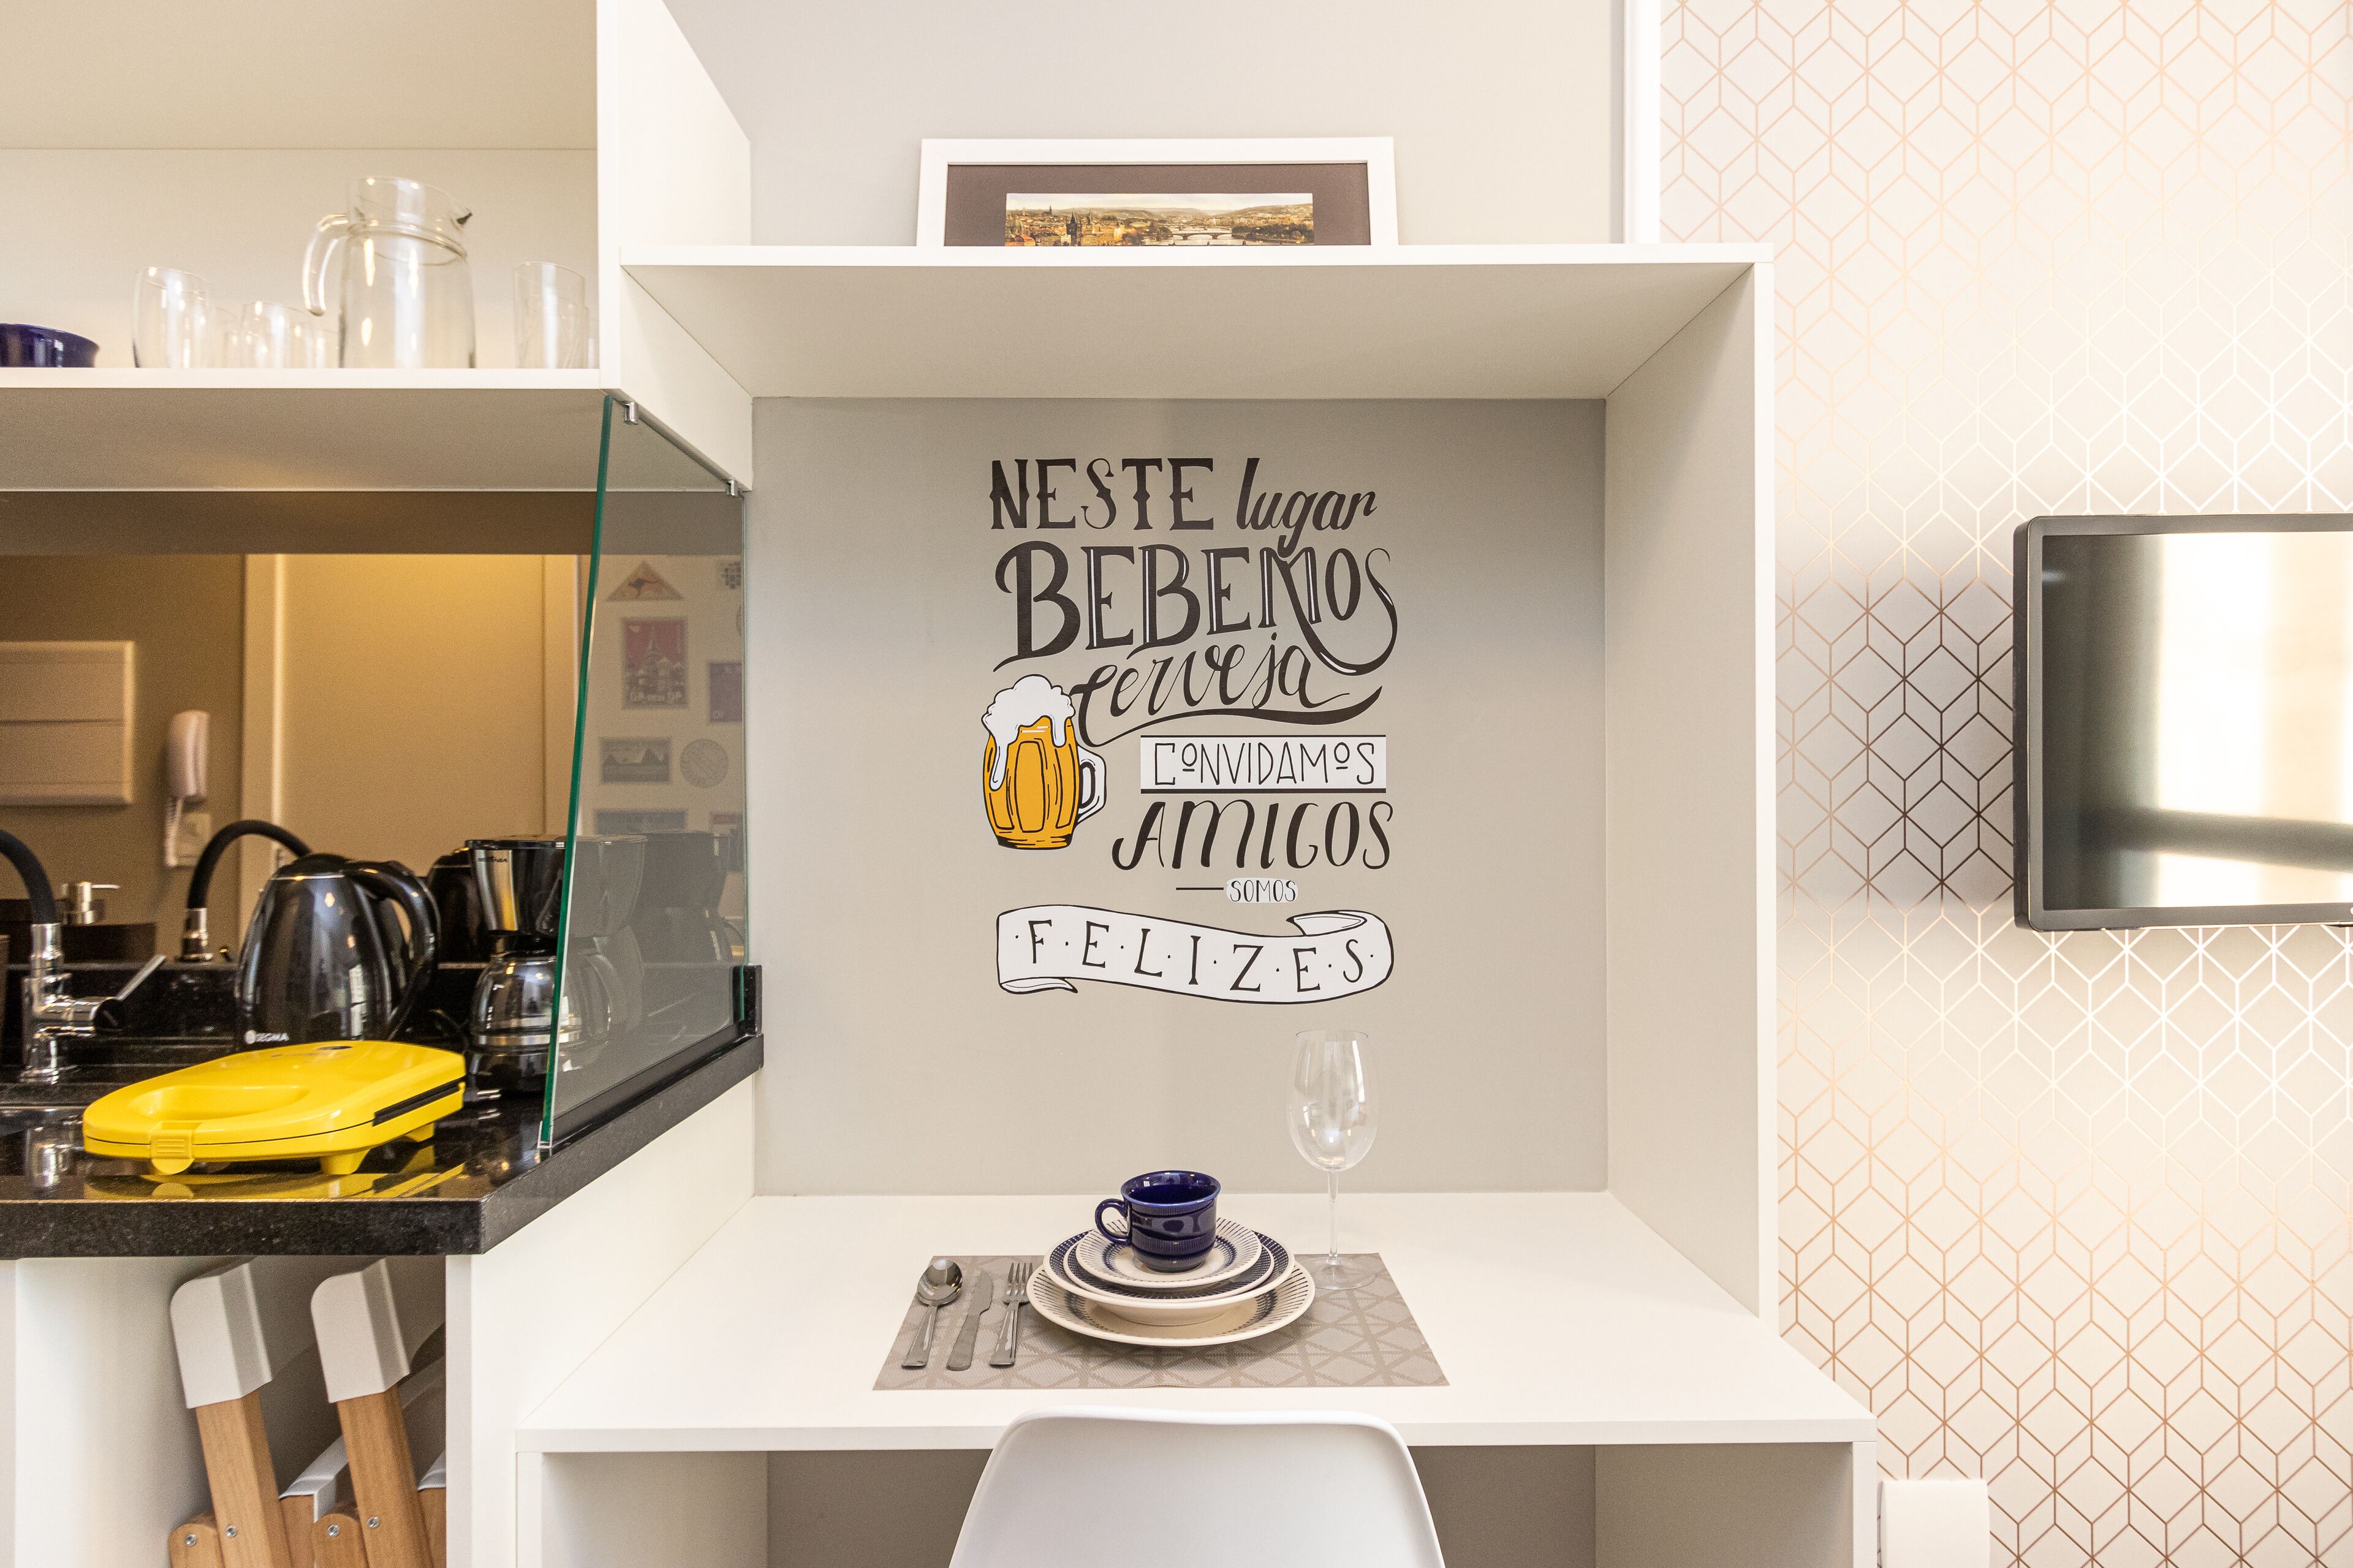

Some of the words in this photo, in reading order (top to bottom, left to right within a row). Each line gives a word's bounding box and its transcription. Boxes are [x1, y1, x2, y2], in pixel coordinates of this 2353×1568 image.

[989, 457, 1214, 531] NESTE
[1237, 457, 1377, 558] lugar
[993, 540, 1398, 676] BEBEMOS
[1112, 799, 1393, 871] AMIGOS
[1230, 879, 1296, 903] SOMOS
